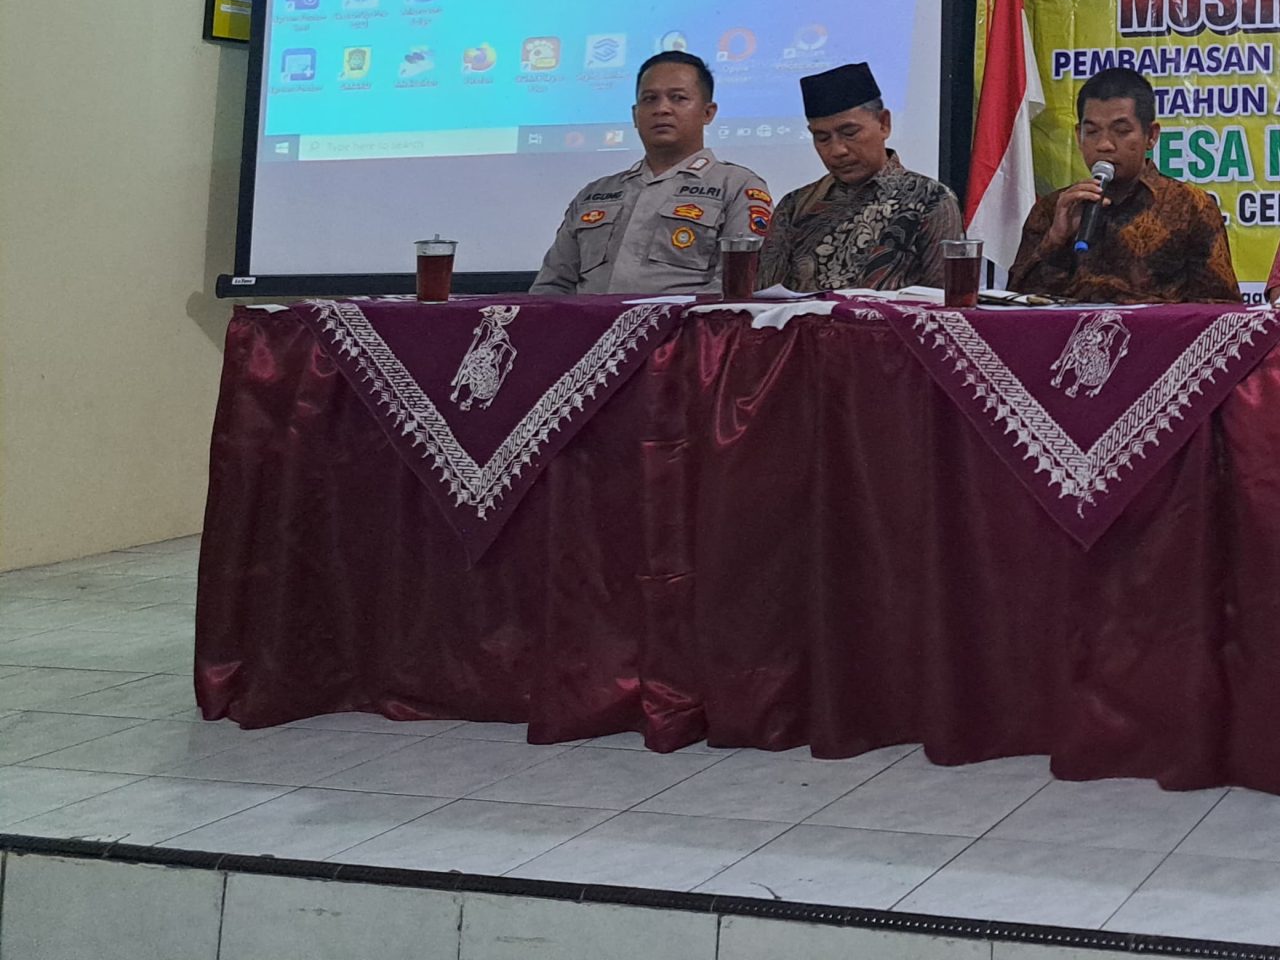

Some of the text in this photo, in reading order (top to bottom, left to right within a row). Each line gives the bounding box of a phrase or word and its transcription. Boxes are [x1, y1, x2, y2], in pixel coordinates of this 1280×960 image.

[1054, 45, 1271, 77] PEMBAHASAN
[1155, 87, 1266, 114] TAHUN
[1145, 129, 1249, 178] ESA
[679, 185, 721, 197] POLRI
